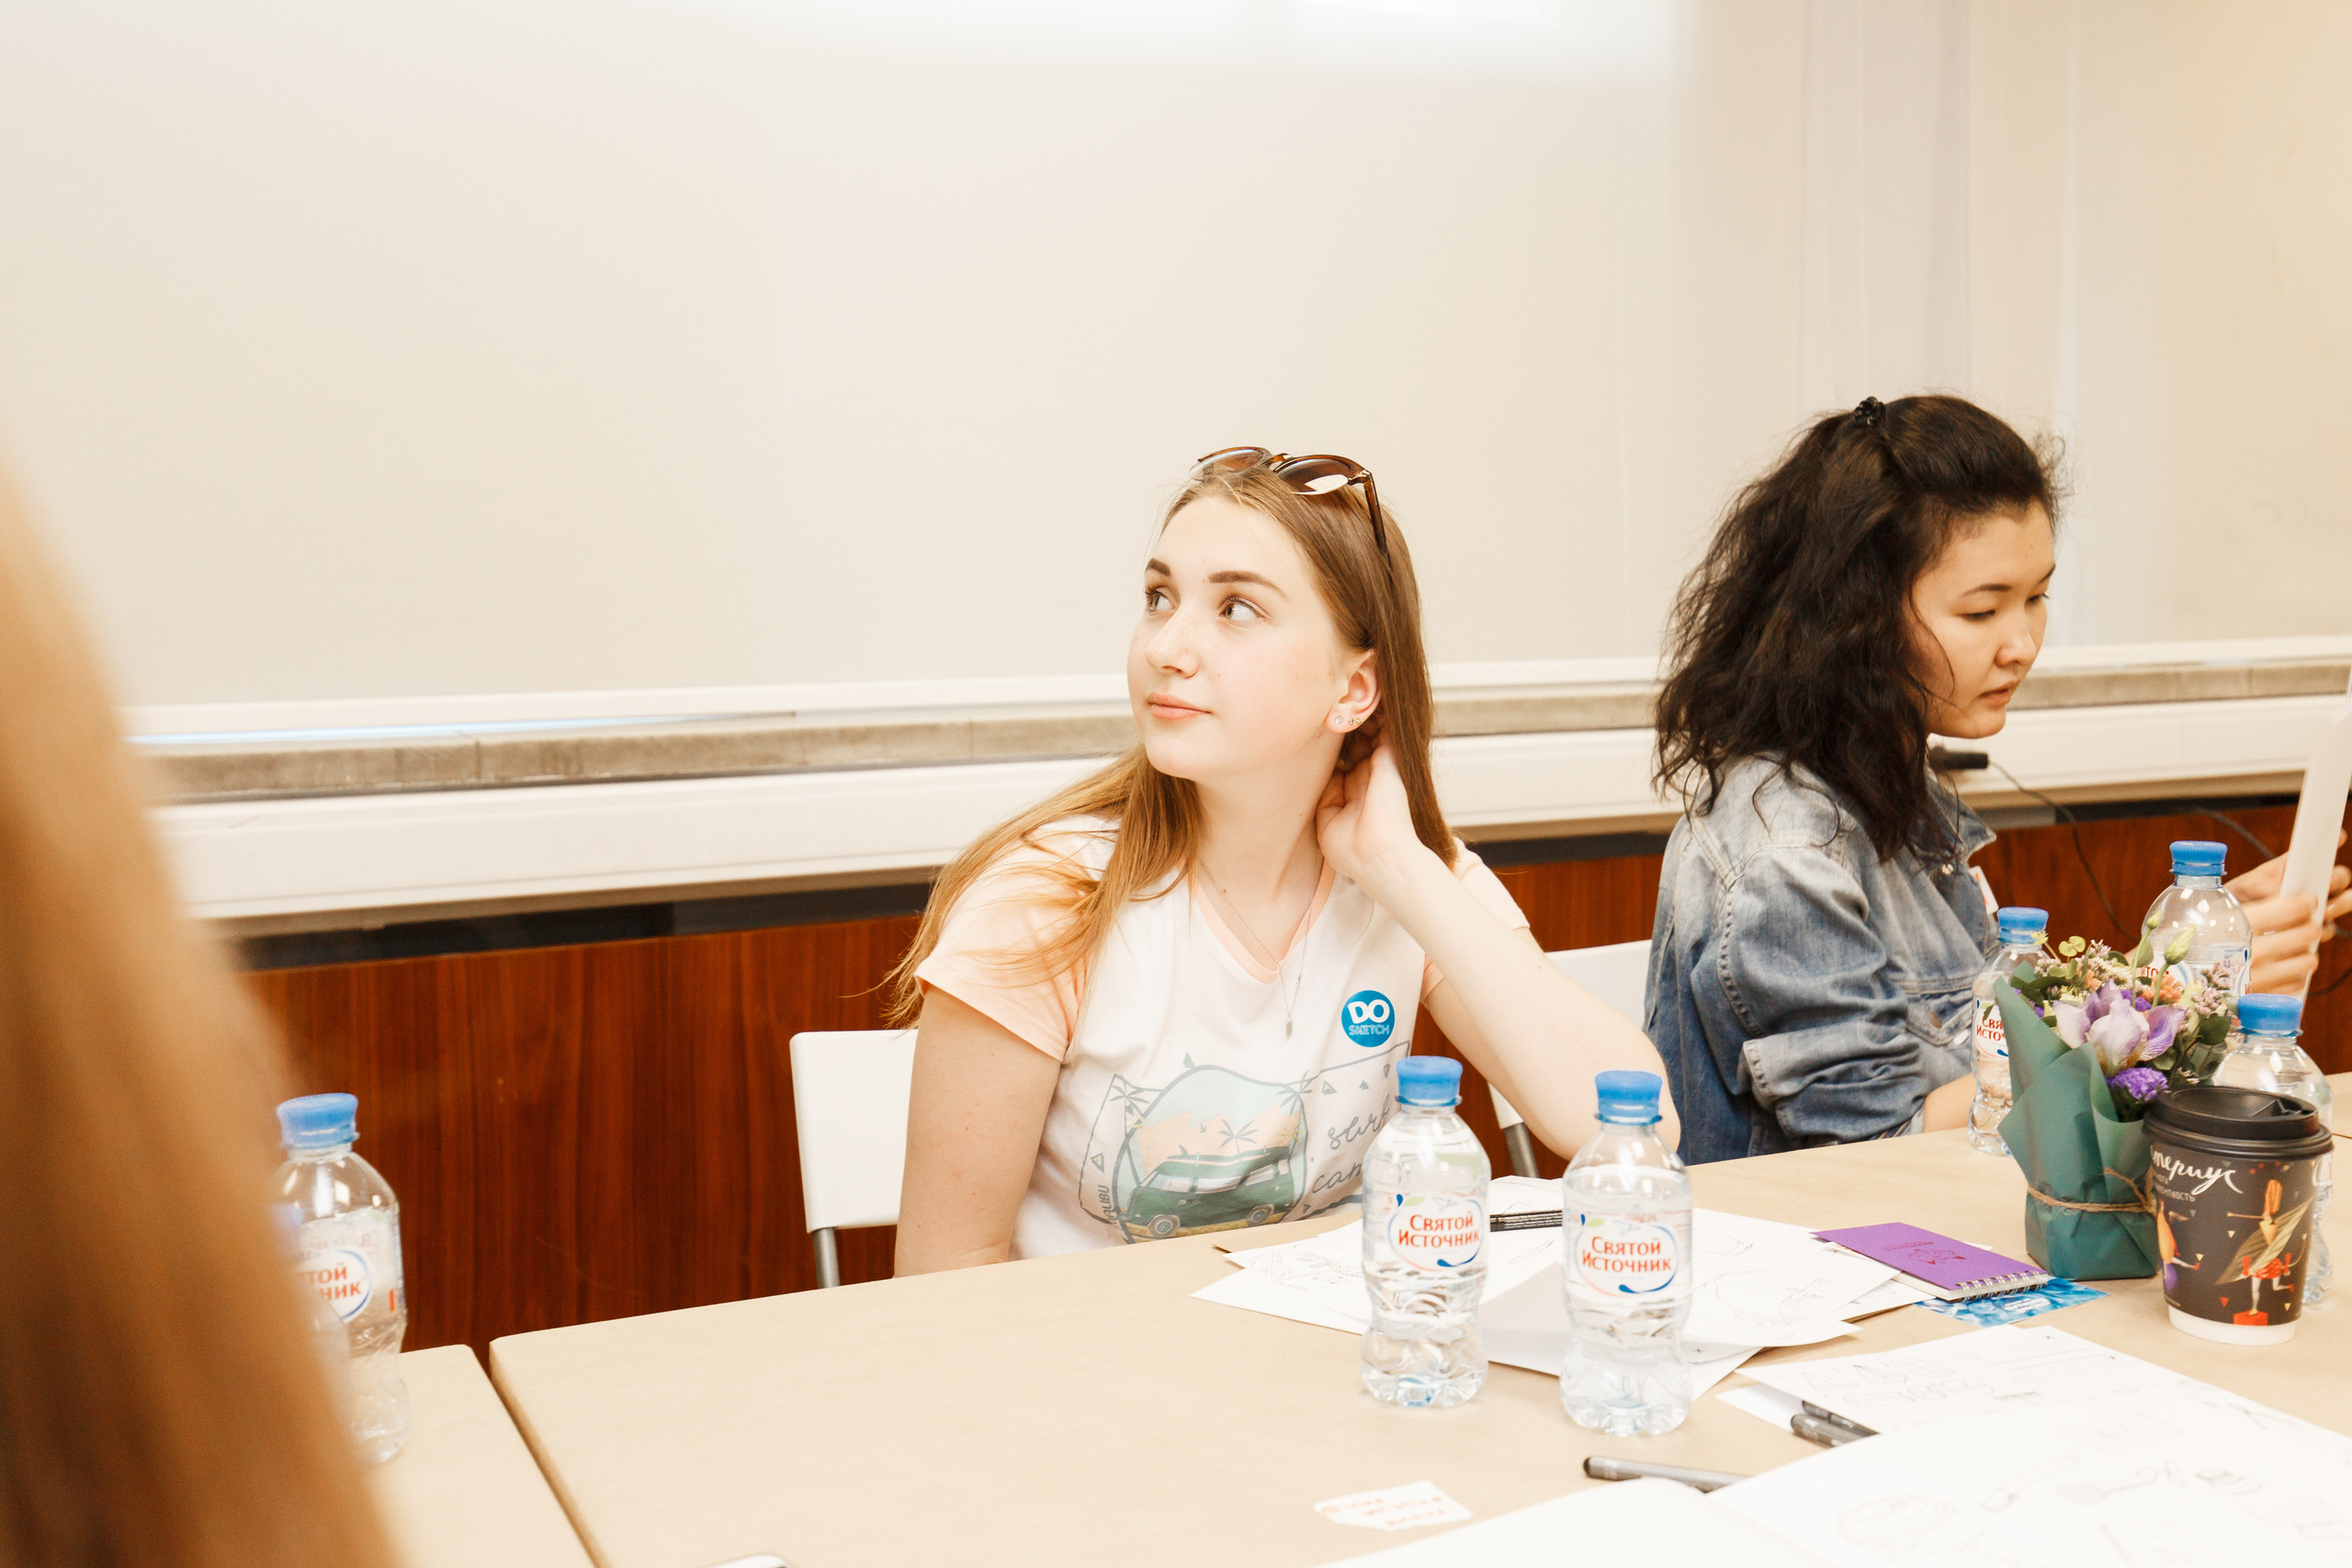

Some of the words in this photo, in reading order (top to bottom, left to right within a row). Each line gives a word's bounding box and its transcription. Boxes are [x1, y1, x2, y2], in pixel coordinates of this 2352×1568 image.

[1348, 999, 1390, 1024] DO
[1349, 1025, 1390, 1036] SKETCH
[1409, 1211, 1474, 1232] Святой
[1398, 1229, 1480, 1248] Источник
[1591, 1235, 1660, 1256] Святой
[1582, 1249, 1672, 1273] Источник
